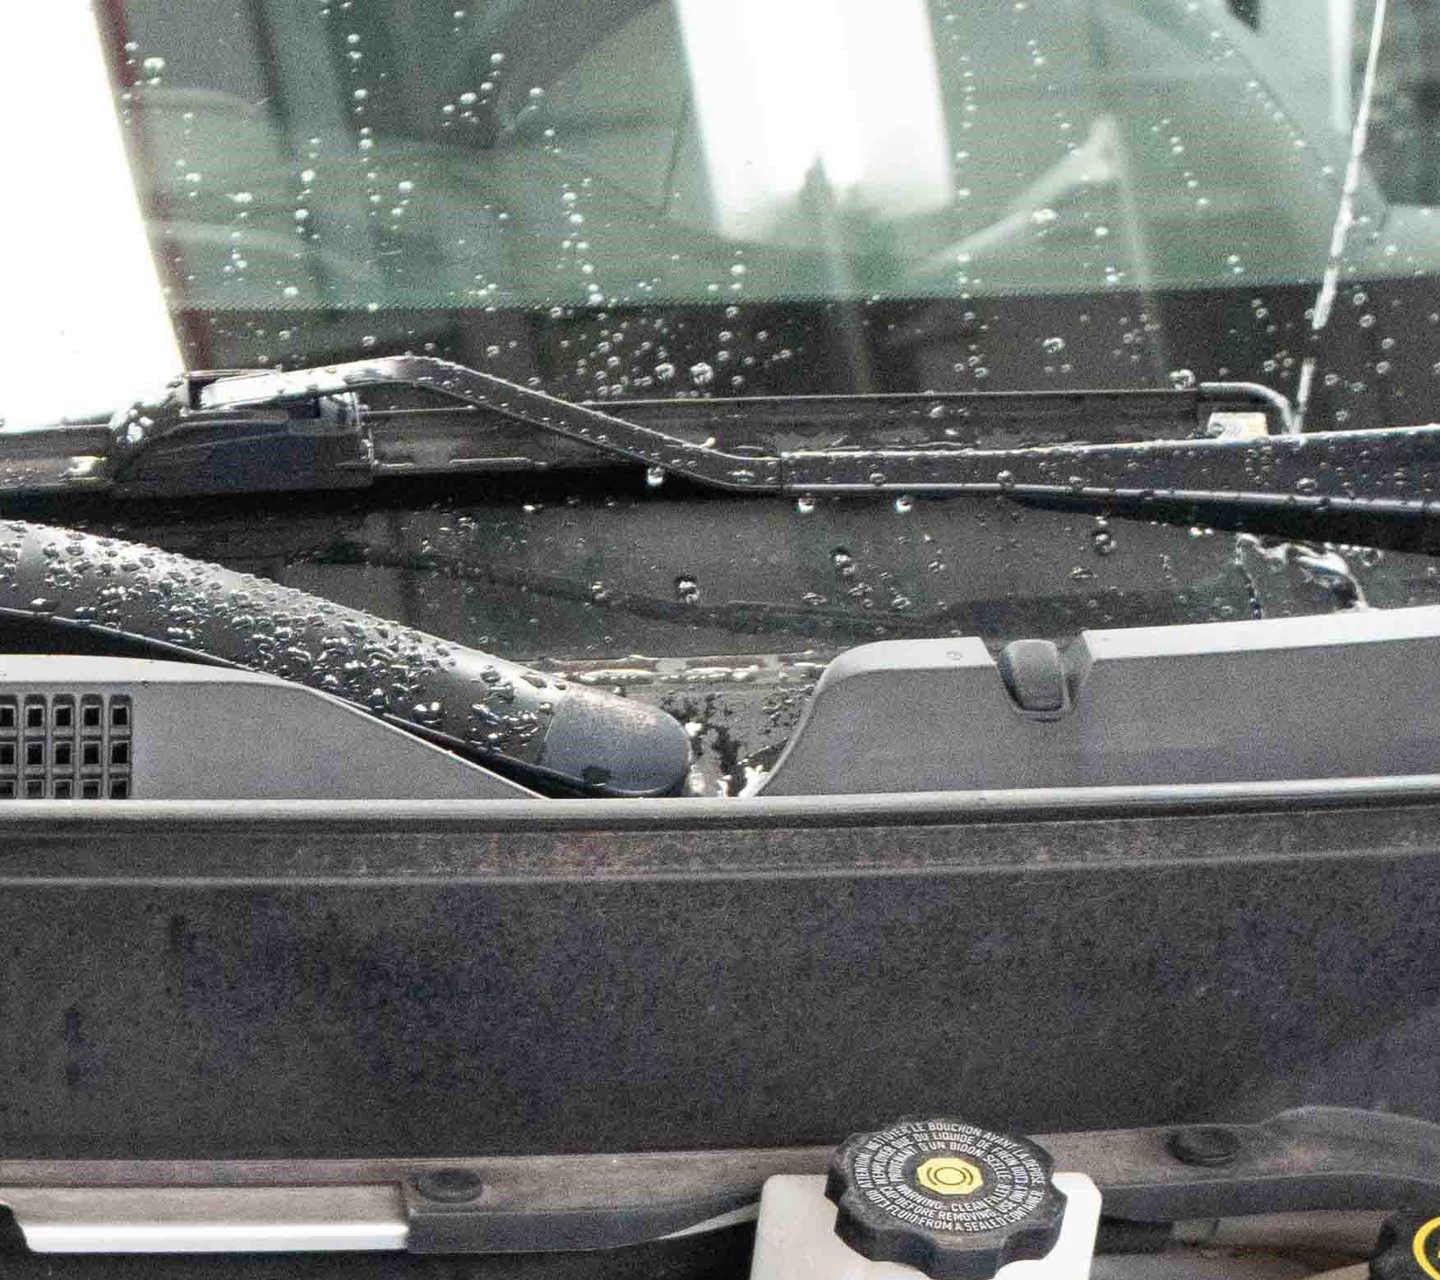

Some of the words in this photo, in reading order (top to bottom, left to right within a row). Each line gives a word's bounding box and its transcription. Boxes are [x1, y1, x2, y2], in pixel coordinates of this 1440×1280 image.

[927, 1121, 982, 1137] BOUCHON
[982, 1131, 1021, 1150] AVANT
[1012, 1148, 1030, 1160] LA
[932, 1131, 975, 1145] LIQUIDE
[976, 1138, 993, 1151] DE
[991, 1146, 1021, 1167] FREIN
[949, 1141, 985, 1157] BIDON
[880, 1186, 901, 1199] CAP
[894, 1196, 937, 1218] BEFORE
[951, 1200, 988, 1212] CLEAN
[886, 1204, 919, 1223] FLUID
[919, 1217, 953, 1232] FROM
[954, 1221, 965, 1232] A
[964, 1216, 1007, 1232] SEALED
